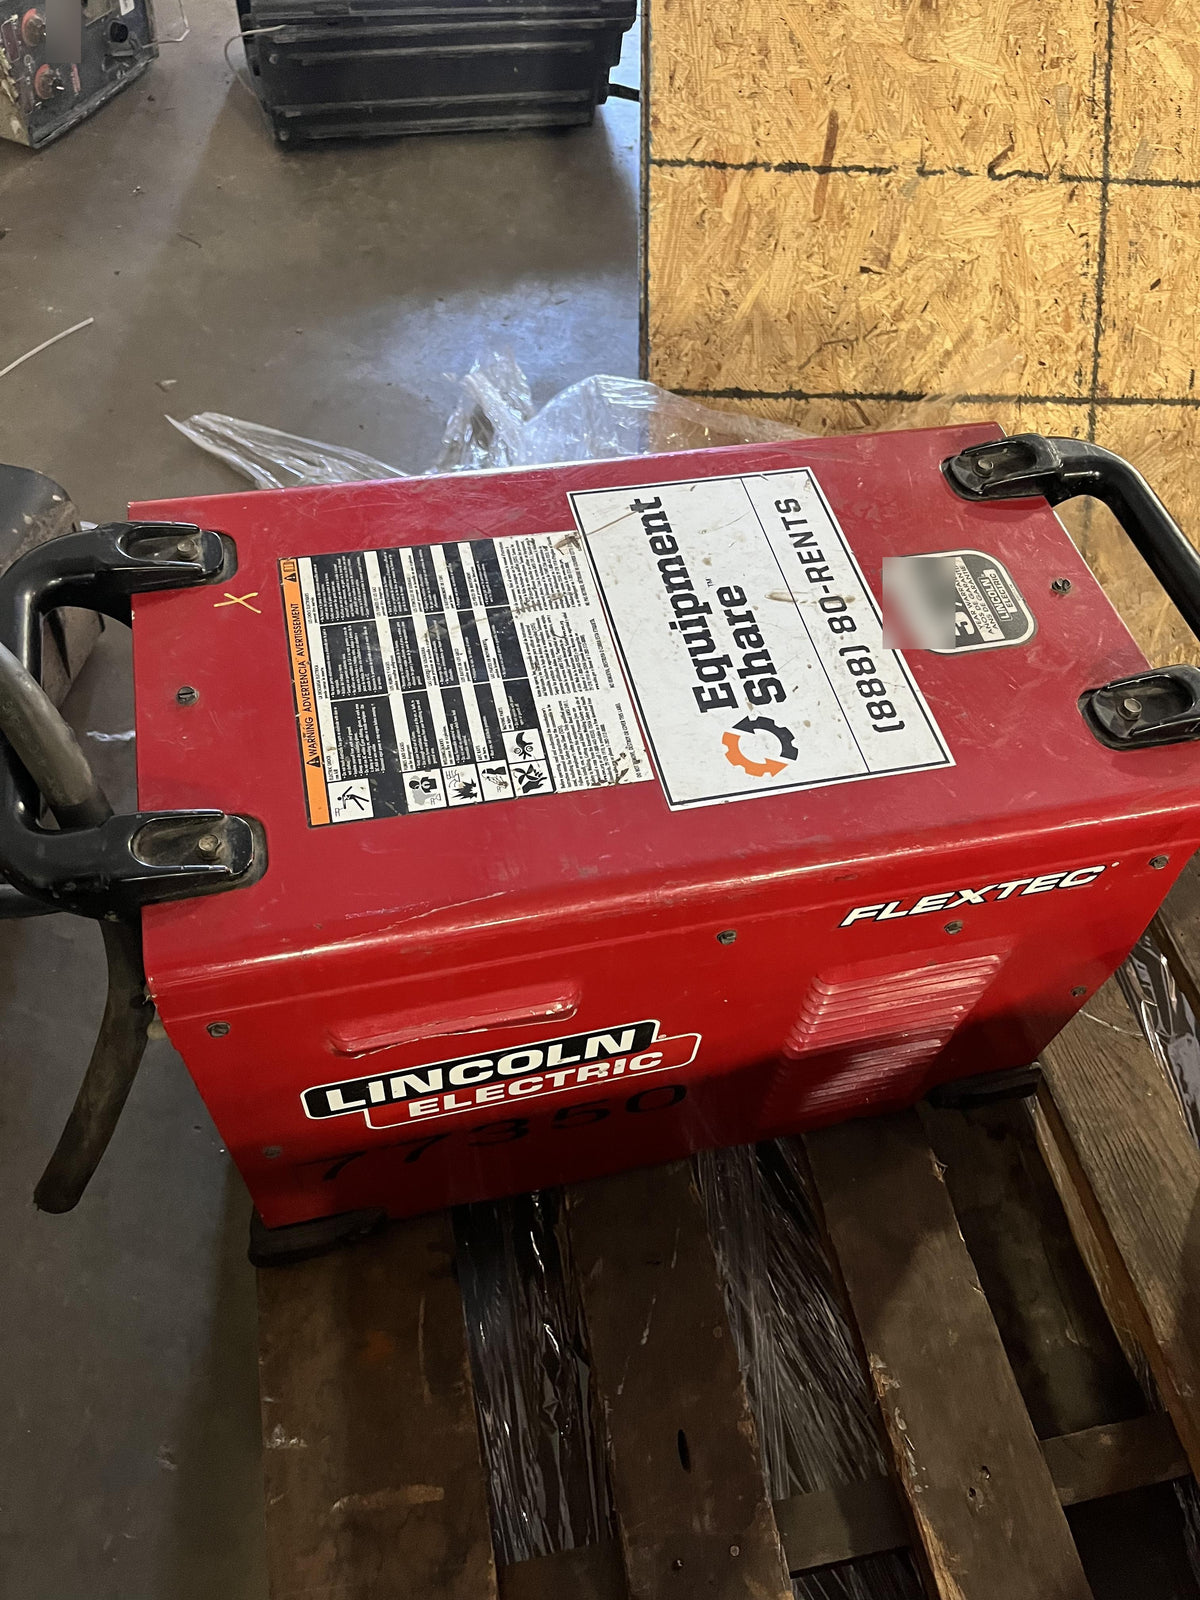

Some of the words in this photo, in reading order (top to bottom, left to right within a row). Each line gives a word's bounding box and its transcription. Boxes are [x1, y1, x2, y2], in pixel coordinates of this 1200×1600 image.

[775, 498, 857, 634] 80-RENTS
[960, 565, 982, 601] GARANTIE
[630, 496, 738, 713] Equipment
[955, 577, 972, 608] WARRA
[972, 601, 981, 611] DE
[980, 578, 1010, 619] LINCOLN
[980, 603, 988, 612] DE
[989, 573, 1014, 608] ELECTRIC
[292, 603, 305, 656] AVERTISSEMENT
[970, 610, 983, 629] YEAR
[986, 613, 998, 629] ANS
[716, 585, 787, 705] Share
[300, 660, 312, 712] ADVERTENCIA
[839, 645, 905, 732] (888)
[304, 716, 317, 756] WARNING
[838, 864, 1107, 928] FLEXTEC
[325, 1029, 637, 1111] LINCOLN
[408, 1051, 664, 1118] ELECTRIC
